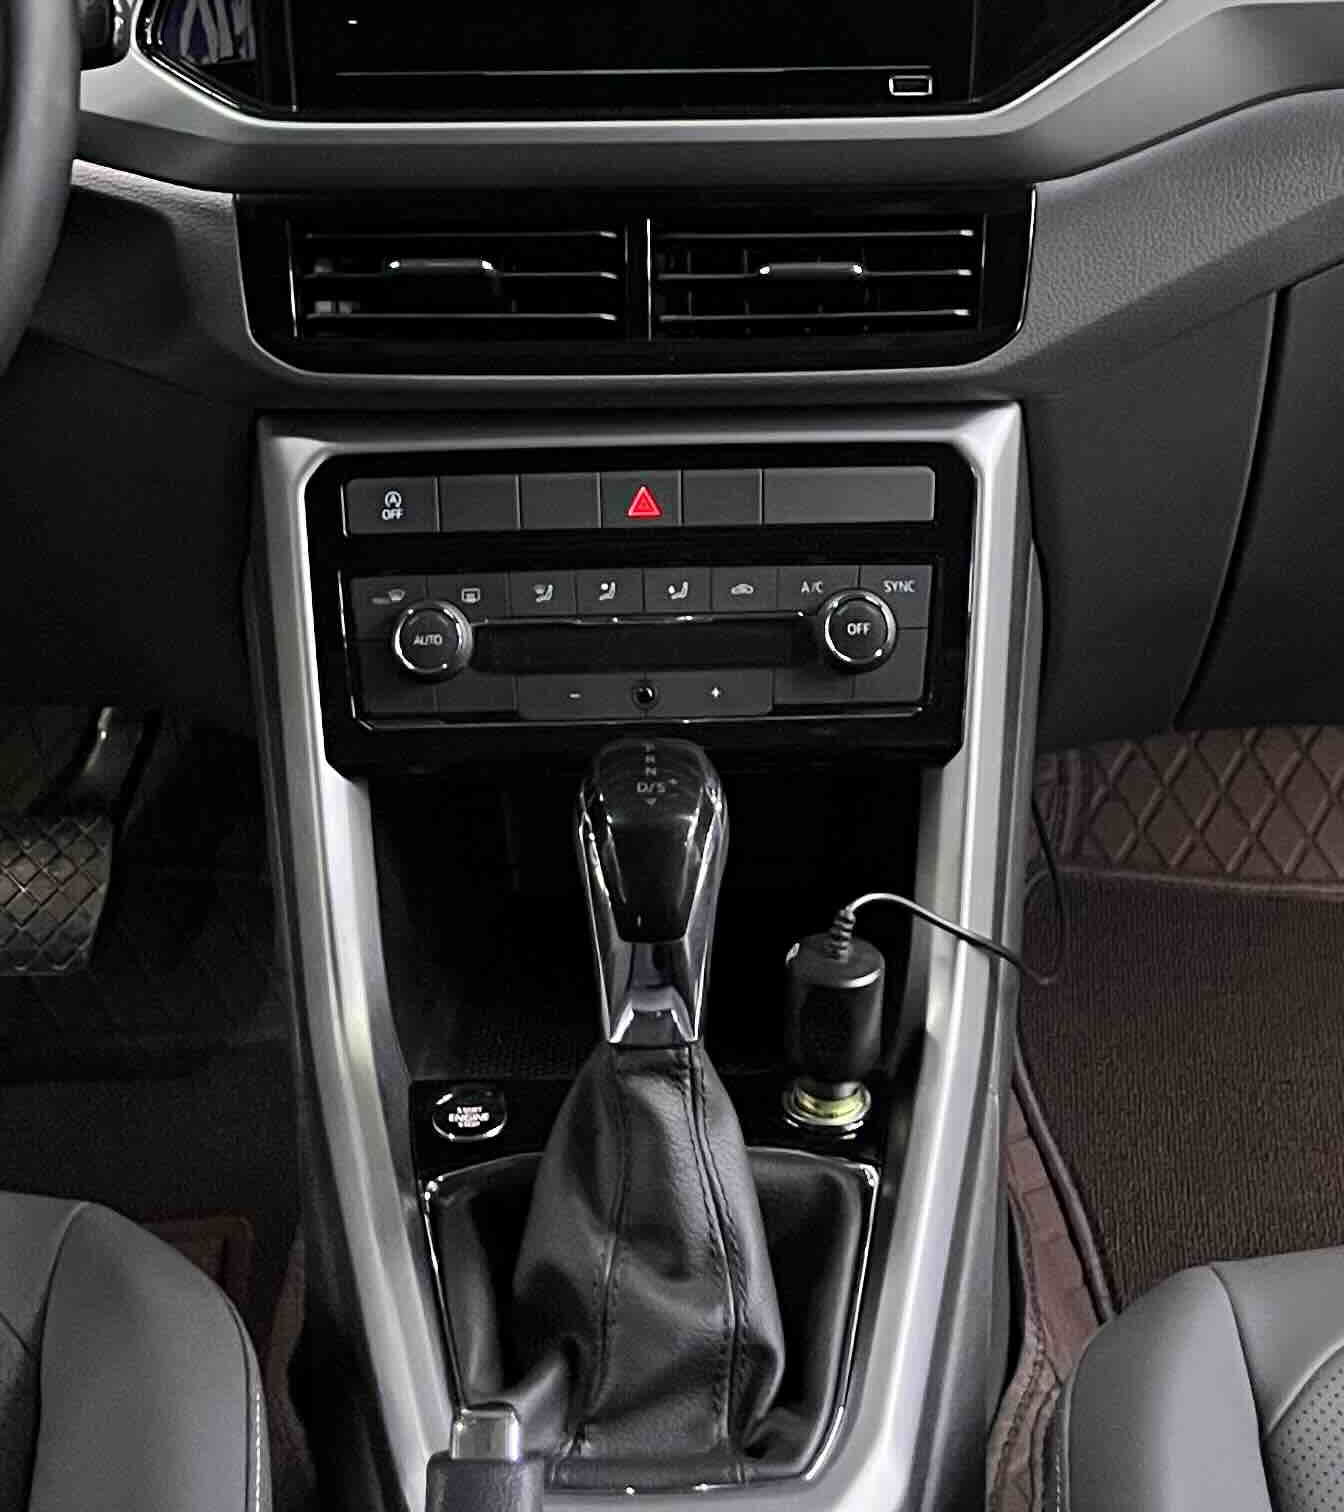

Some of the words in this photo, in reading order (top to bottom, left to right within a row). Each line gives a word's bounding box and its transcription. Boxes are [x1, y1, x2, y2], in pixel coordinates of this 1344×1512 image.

[381, 508, 405, 520] OFF
[800, 580, 824, 593] A/C
[883, 579, 916, 593] SYNC
[847, 622, 872, 636] OFF
[413, 634, 443, 646] AUTO
